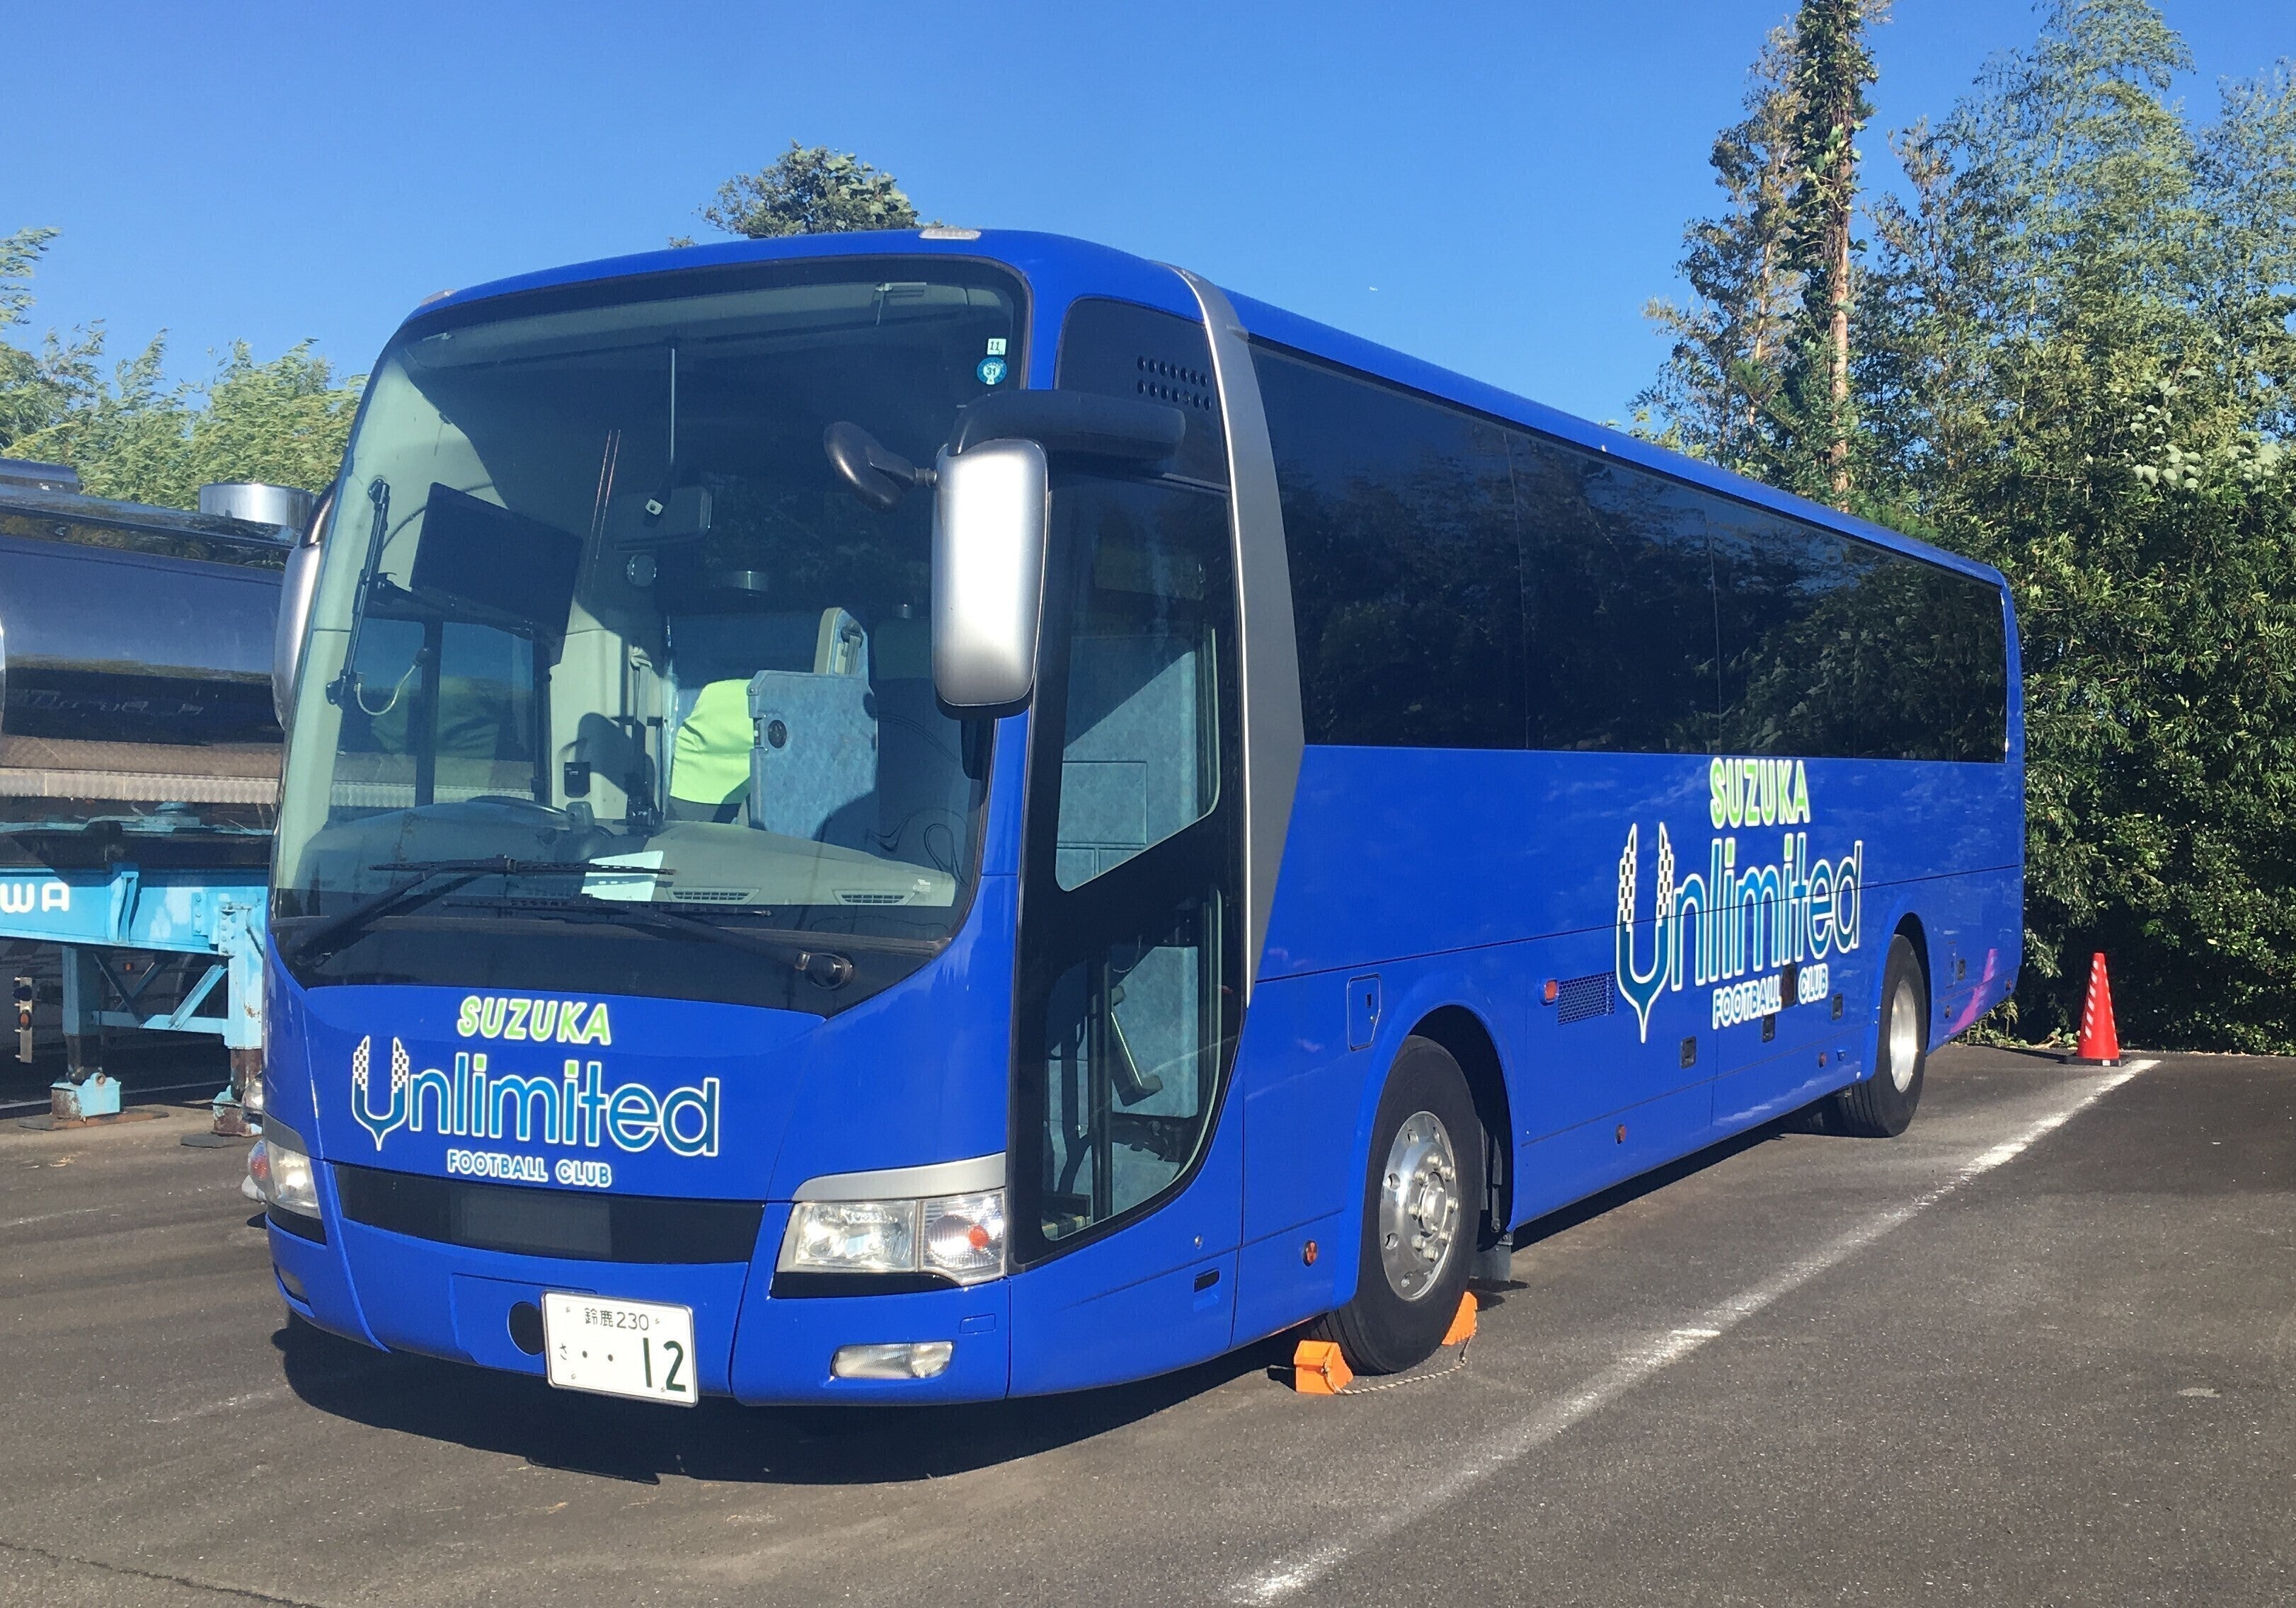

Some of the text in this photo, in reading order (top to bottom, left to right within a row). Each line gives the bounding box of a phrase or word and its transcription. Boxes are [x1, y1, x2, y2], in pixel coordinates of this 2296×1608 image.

[1710, 757, 1810, 829] SUZUKA
[1616, 822, 1862, 1043] Unlimited
[457, 996, 612, 1046] SUZUKA
[1711, 963, 1829, 1030] FOOTBALL CLUB
[352, 1035, 721, 1157] Unlimited
[447, 1149, 612, 1188] FOOTBALL CLUB
